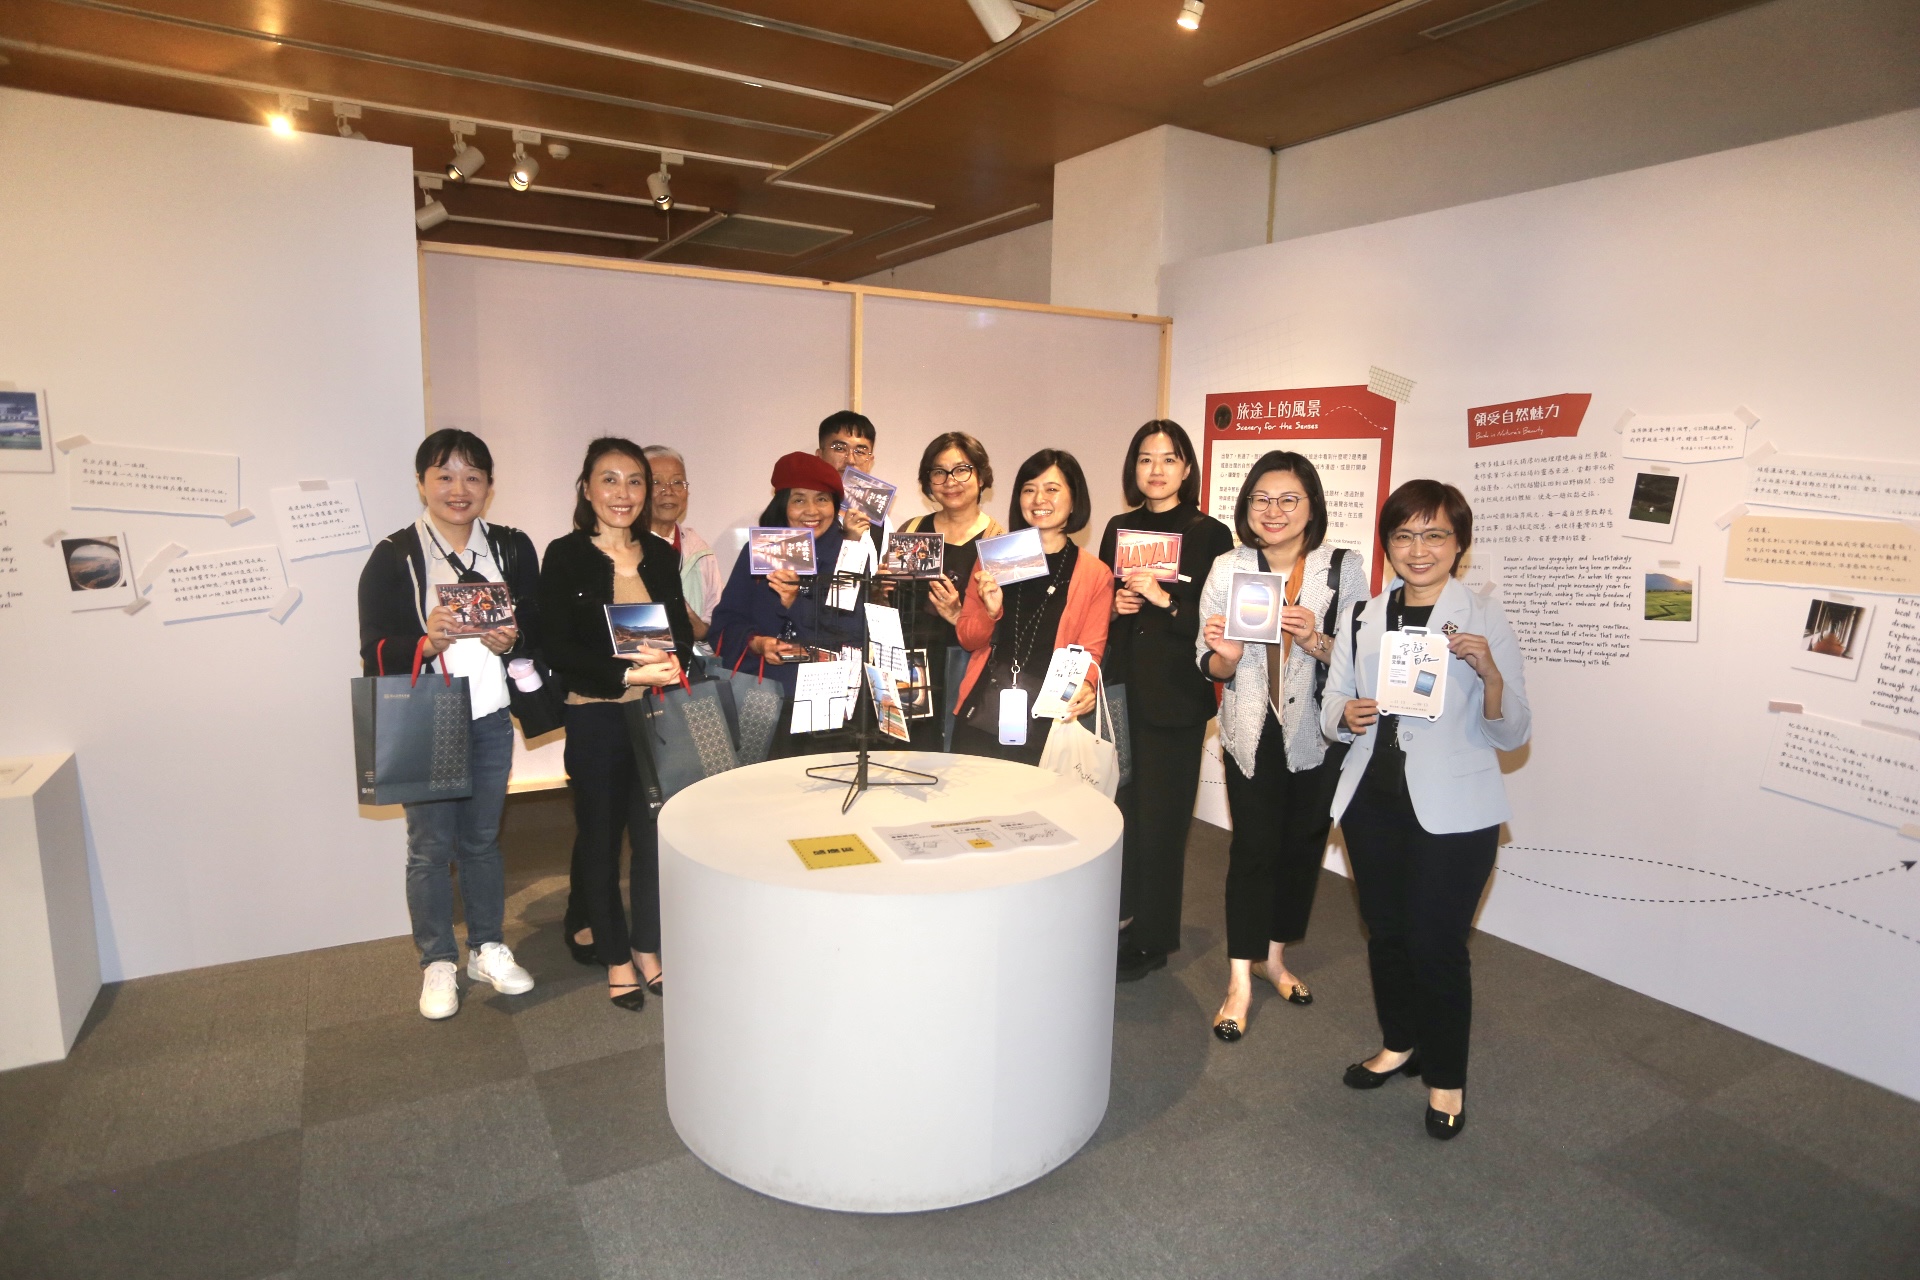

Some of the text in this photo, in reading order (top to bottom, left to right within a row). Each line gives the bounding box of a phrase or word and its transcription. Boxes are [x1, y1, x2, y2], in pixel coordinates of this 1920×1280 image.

[1236, 400, 1321, 420] 旅途上的風景
[1474, 404, 1560, 427] 領受自然魅力
[1236, 423, 1261, 434] Scenery
[1264, 422, 1276, 430] for
[1295, 421, 1319, 430] Senses
[1497, 428, 1521, 437] Nature's
[1522, 426, 1544, 436] Beauty
[1117, 541, 1179, 568] HAWAII
[1548, 556, 1574, 564] geography
[1592, 555, 1632, 563] breathtakingly
[1530, 600, 1548, 608] through
[1877, 678, 1905, 693] Through
